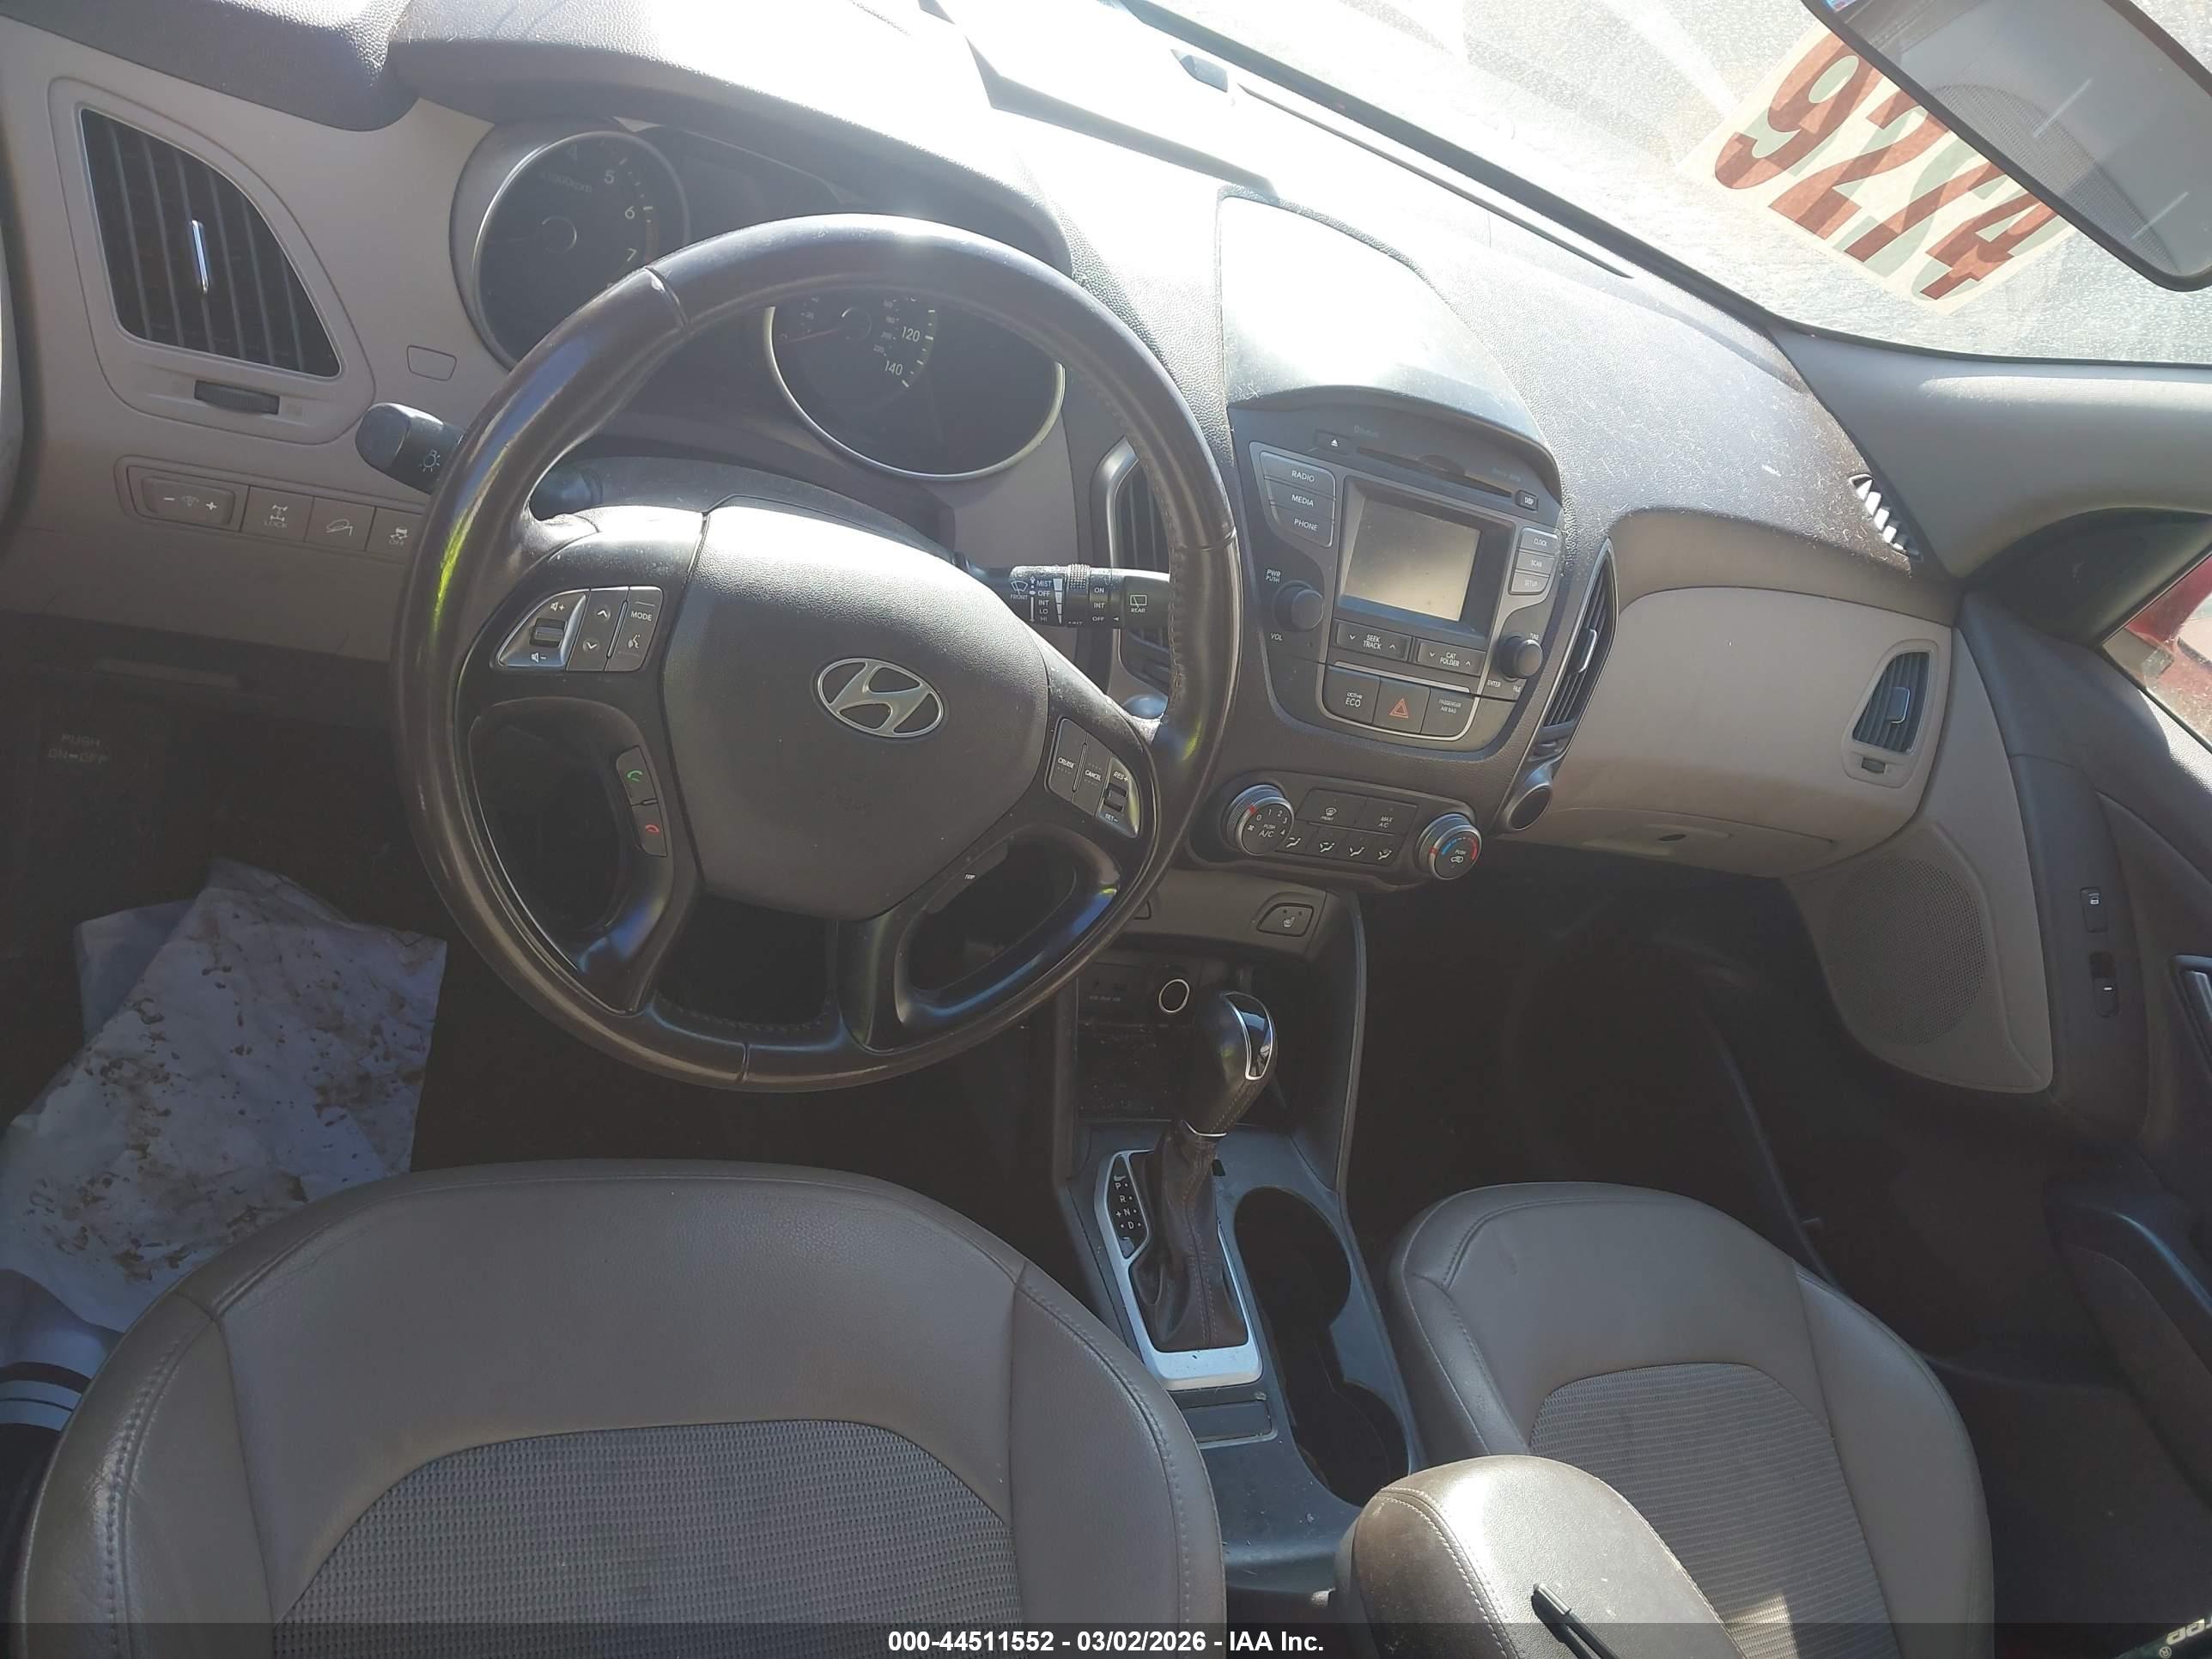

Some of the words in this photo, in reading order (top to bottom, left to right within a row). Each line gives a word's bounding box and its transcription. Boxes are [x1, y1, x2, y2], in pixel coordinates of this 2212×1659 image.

[604, 169, 615, 185] 5
[624, 205, 635, 220] 6
[626, 248, 638, 261] 7
[902, 325, 921, 342] 120
[884, 360, 903, 375] 140
[1291, 470, 1315, 482] RADIO
[1291, 494, 1314, 507] MEDIA
[1294, 518, 1319, 531] PHONE
[1267, 568, 1280, 577] PWR
[1266, 574, 1280, 583] PUSH
[630, 611, 653, 622] MODE
[1270, 632, 1283, 641] VOL
[1366, 634, 1381, 642] SEEK
[1363, 640, 1382, 650] TRACK
[1439, 657, 1460, 667] FOLDER
[1345, 697, 1361, 708] ECO
[1057, 757, 1076, 769] CRUISE
[1085, 769, 1102, 781] CANCEL
[1258, 830, 1274, 838] A/C
[1120, 1194, 1127, 1203] R
[1123, 1207, 1131, 1216] N
[1127, 1221, 1134, 1230] D
